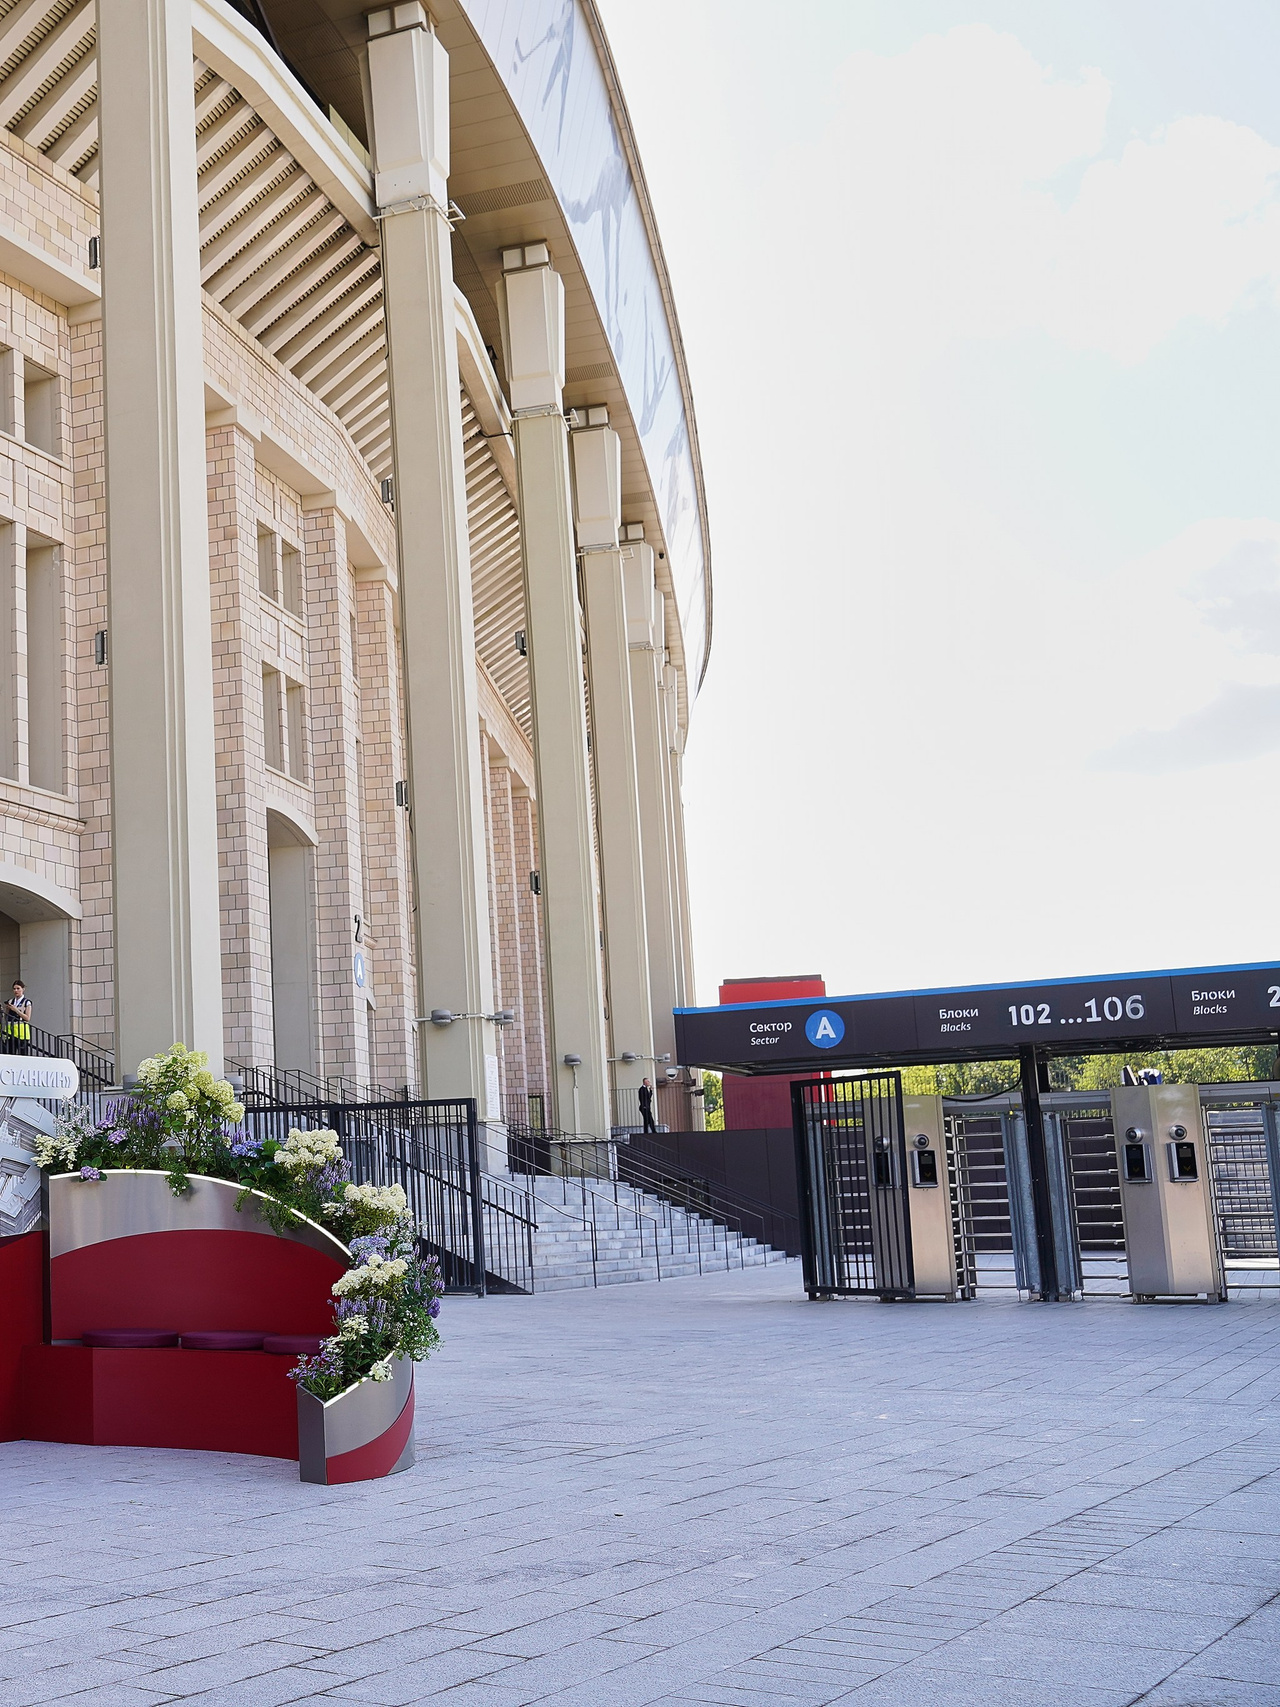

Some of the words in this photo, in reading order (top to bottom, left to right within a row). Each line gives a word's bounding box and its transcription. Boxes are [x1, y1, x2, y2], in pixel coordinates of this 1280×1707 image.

[1191, 989, 1236, 1002] Блоки
[939, 1007, 979, 1020] Блоки
[1008, 1003, 1052, 1026] 102
[1193, 1004, 1228, 1015] Blocks
[749, 1021, 792, 1033] Сектор
[940, 1022, 972, 1033] Blocks
[751, 1036, 780, 1046] Sector
